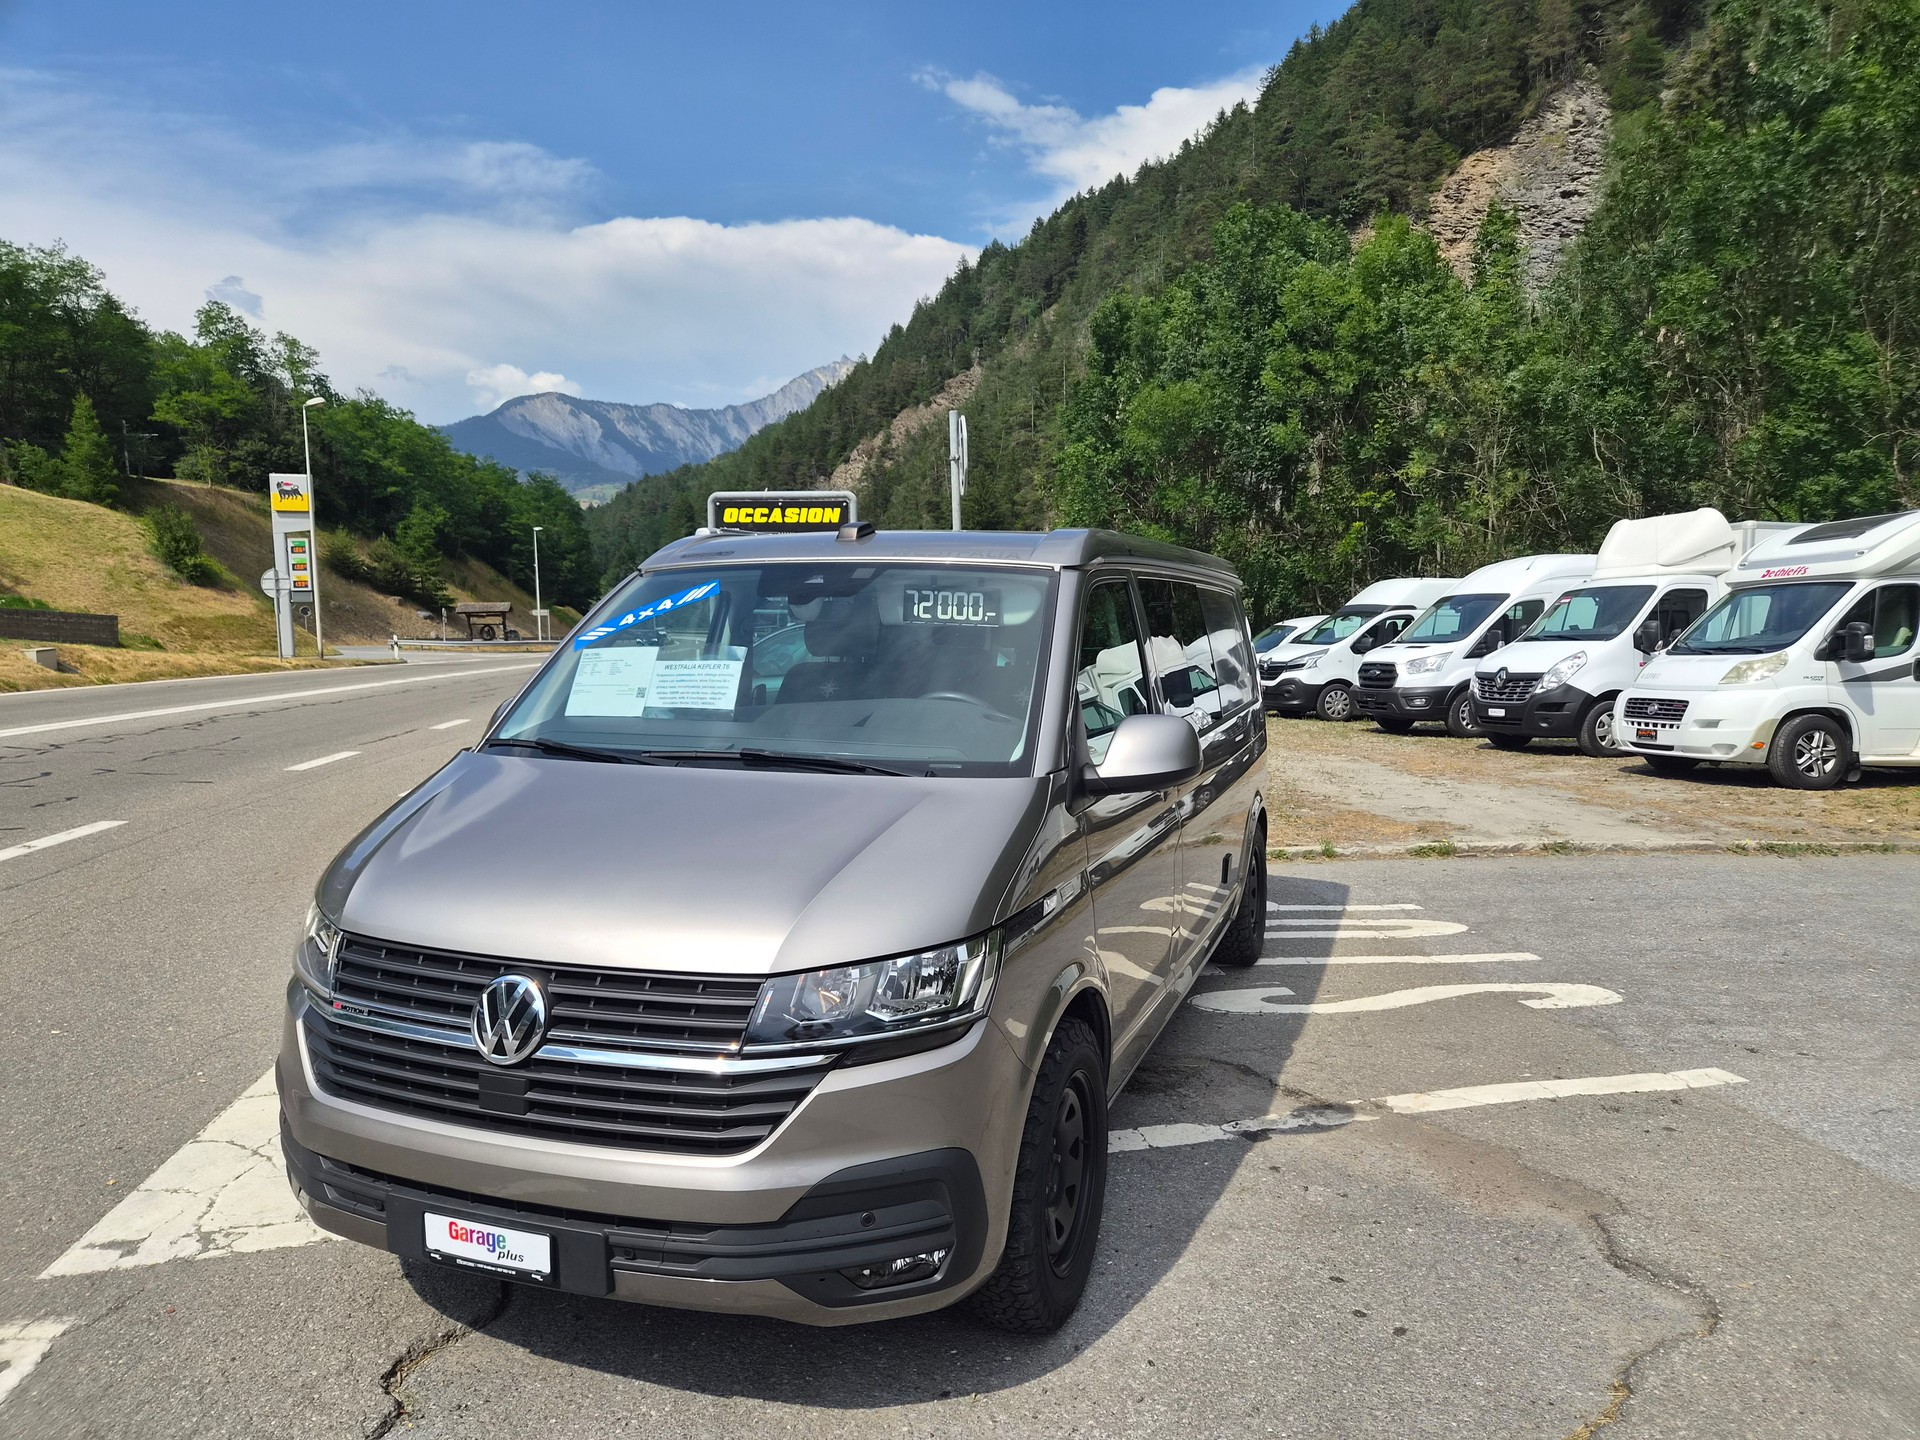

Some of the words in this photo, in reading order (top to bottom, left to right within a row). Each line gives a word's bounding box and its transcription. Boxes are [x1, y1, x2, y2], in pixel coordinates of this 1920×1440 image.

[723, 507, 841, 524] OCCASION
[1761, 566, 1808, 579] Dethleffs
[475, 976, 544, 1062] VW
[448, 1221, 506, 1253] Garage
[497, 1250, 524, 1262] plus
